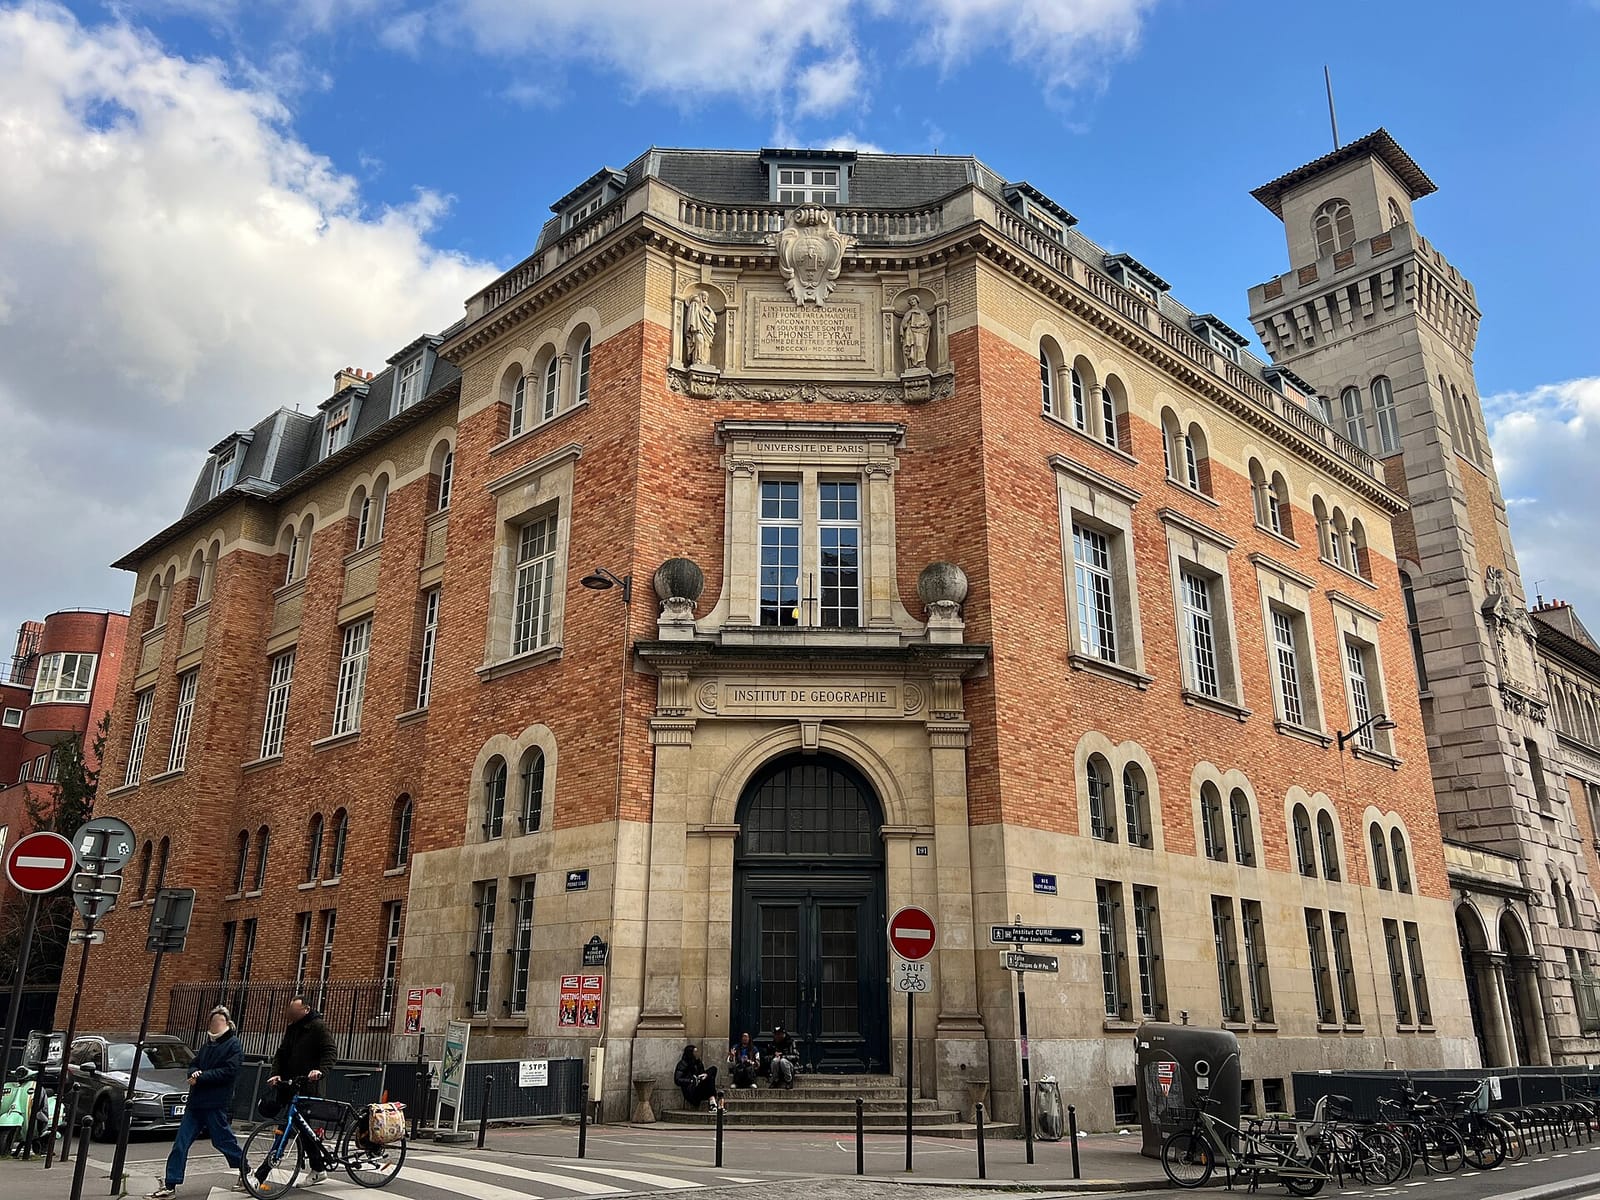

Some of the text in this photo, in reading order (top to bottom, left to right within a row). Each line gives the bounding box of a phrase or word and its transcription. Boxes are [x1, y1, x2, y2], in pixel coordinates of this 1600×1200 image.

[757, 443, 864, 454] UNIVERSITE DE PARIS
[734, 690, 887, 703] INSTITUT DE GEOGRAPHIE
[901, 963, 925, 972] SAUF
[528, 1063, 547, 1071] STPS
